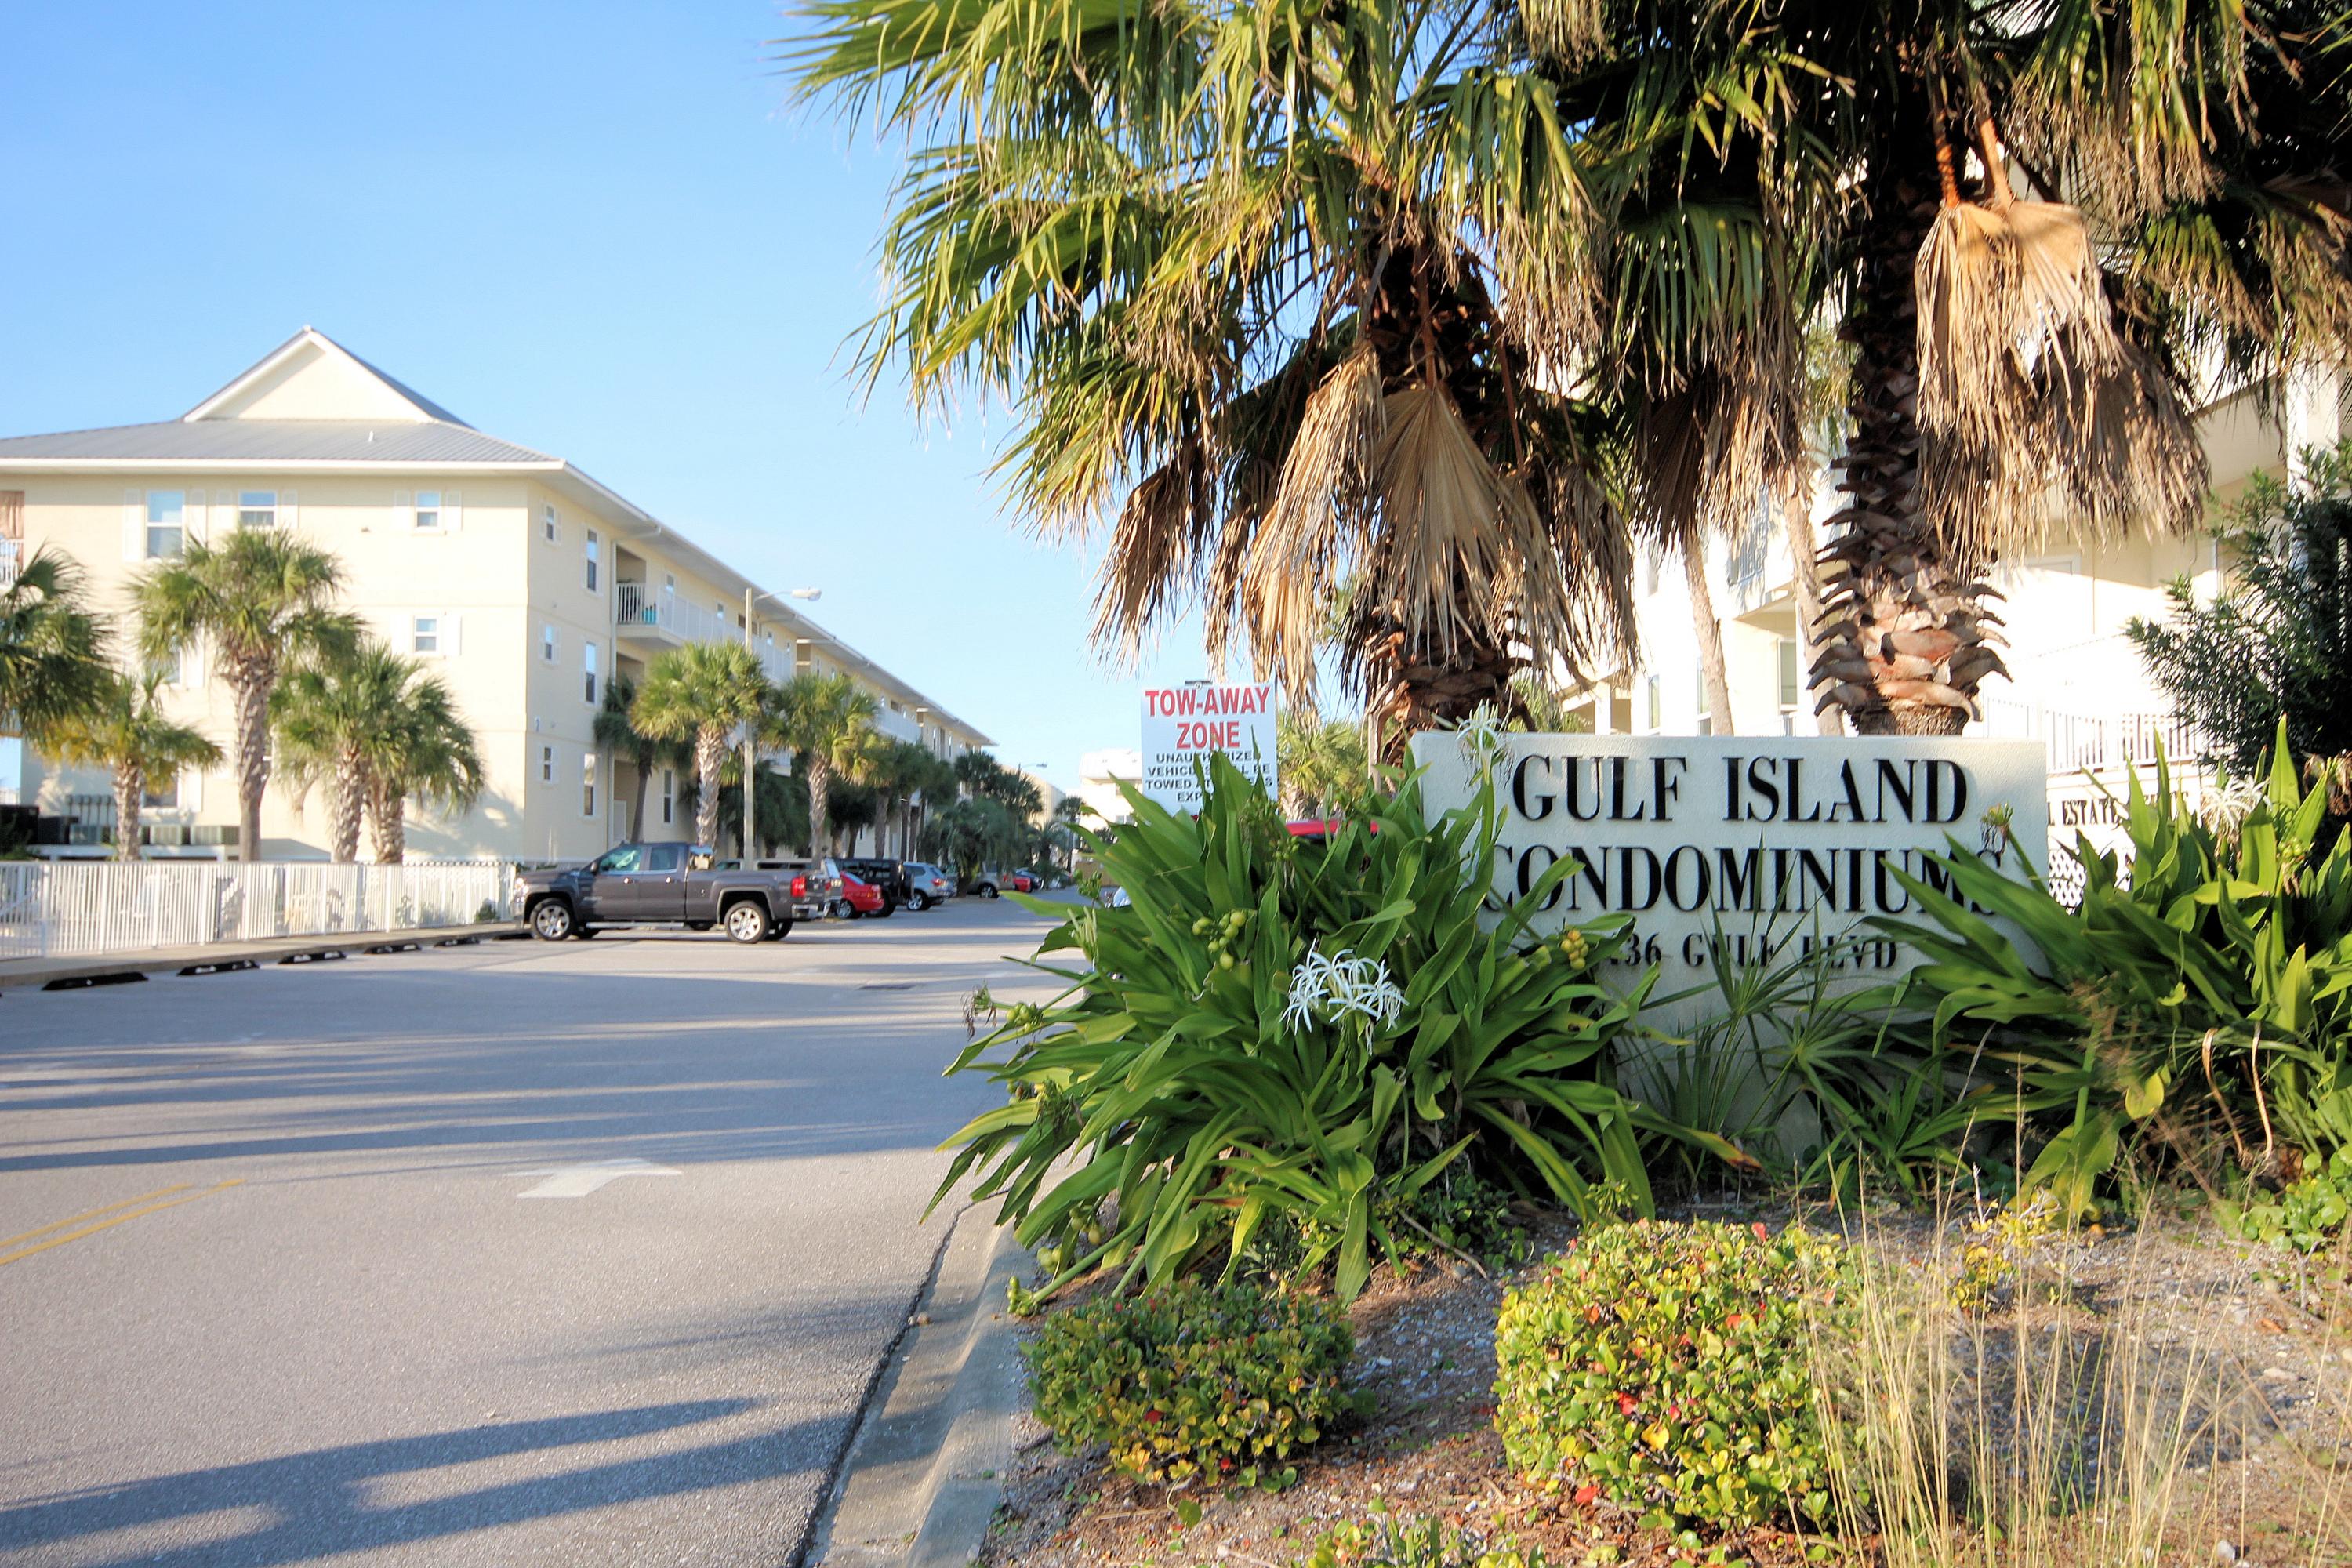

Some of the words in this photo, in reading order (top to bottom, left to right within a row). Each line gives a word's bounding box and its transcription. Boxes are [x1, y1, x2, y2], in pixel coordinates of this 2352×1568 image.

[1145, 686, 1270, 717] TOW-AWAY
[1176, 721, 1240, 750] ZONE
[1145, 778, 1192, 790] TOWED
[1148, 764, 1211, 777] VEHICLS
[1512, 754, 1687, 822] GULF
[1722, 756, 1968, 823] ISLAND
